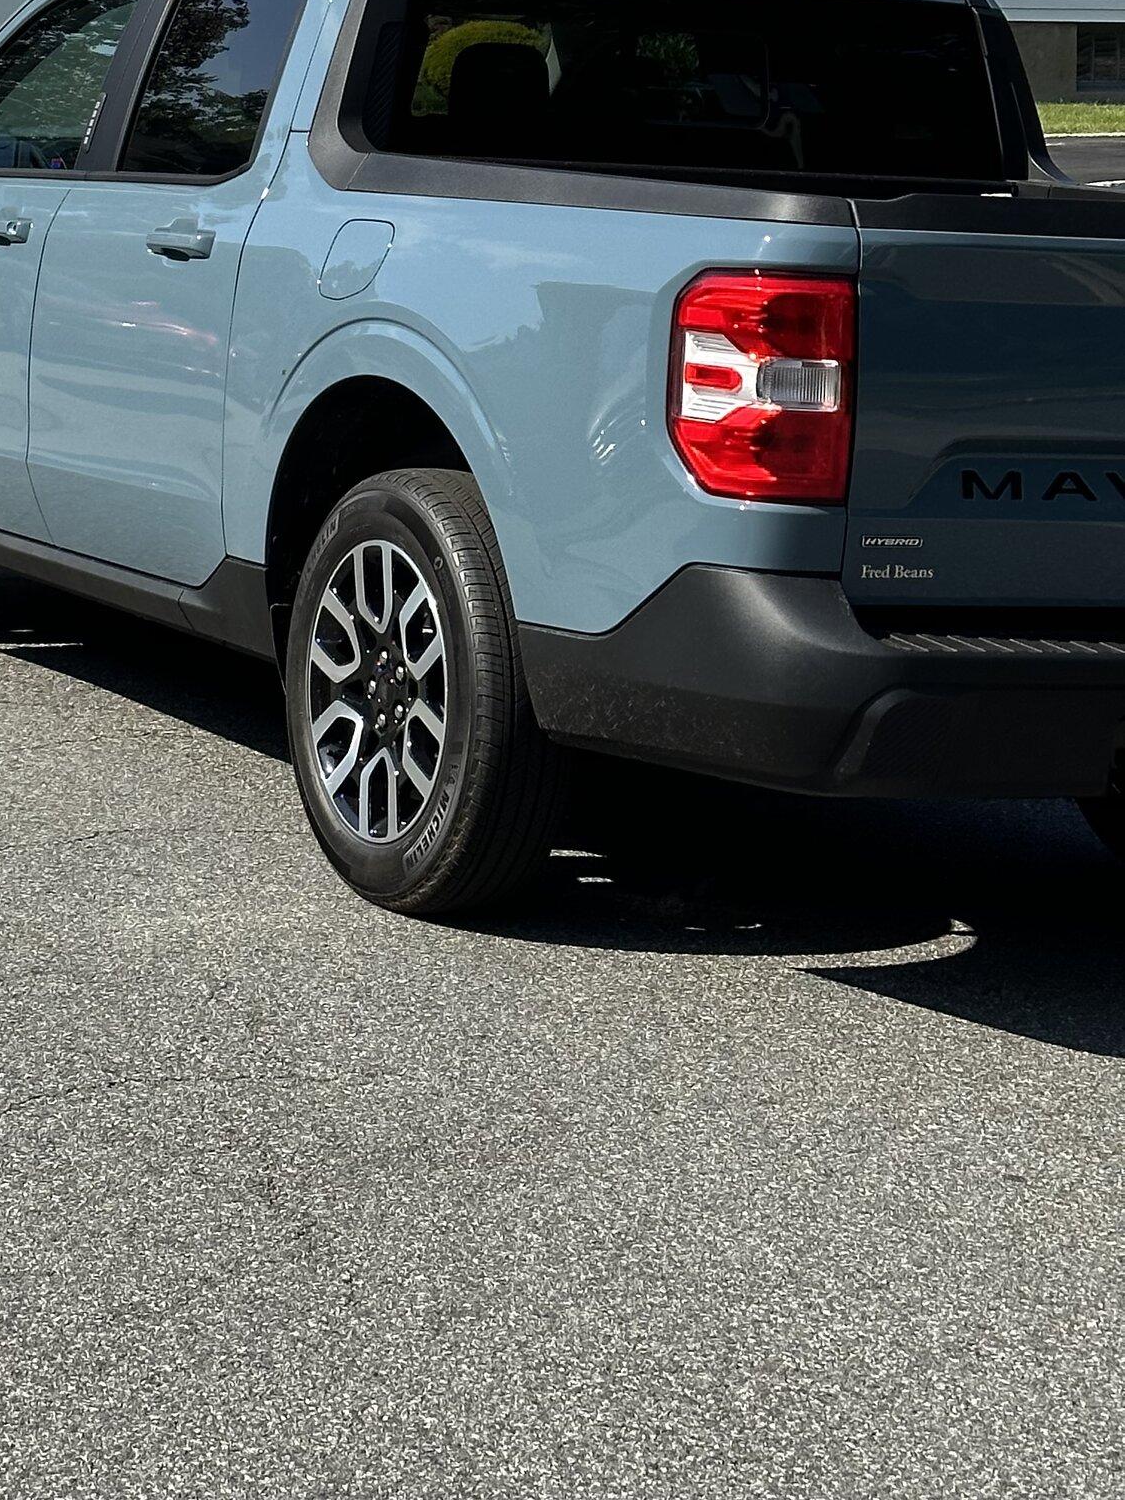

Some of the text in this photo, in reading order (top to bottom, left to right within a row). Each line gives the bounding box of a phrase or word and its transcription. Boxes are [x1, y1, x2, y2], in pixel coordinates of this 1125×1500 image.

[864, 536, 920, 547] HYBRID
[861, 563, 935, 579] Fred Beans
[404, 790, 452, 871] MICHELIN
